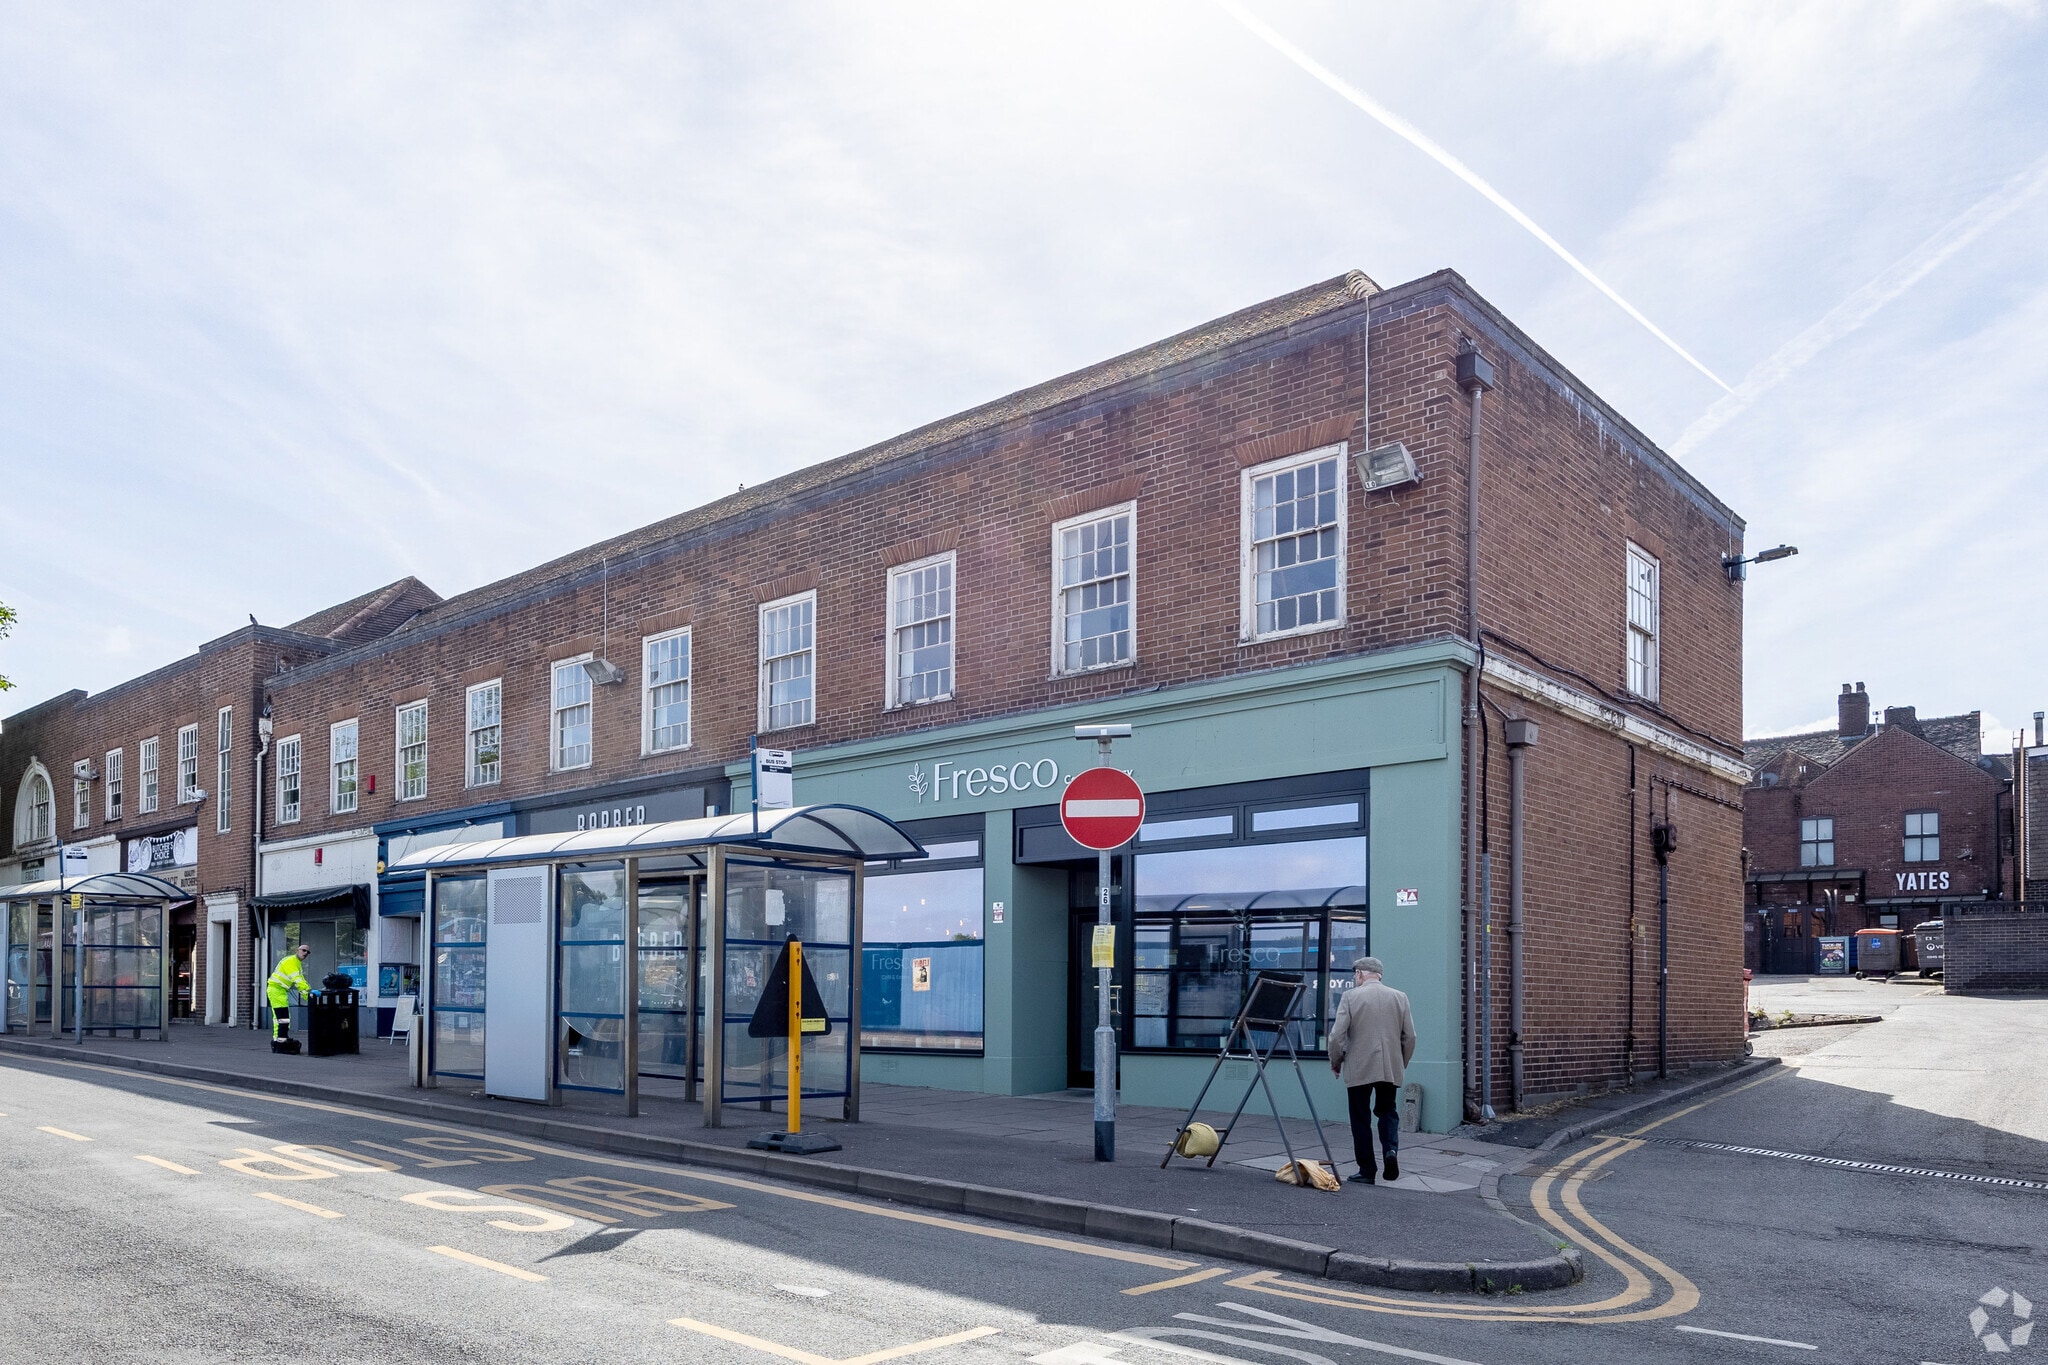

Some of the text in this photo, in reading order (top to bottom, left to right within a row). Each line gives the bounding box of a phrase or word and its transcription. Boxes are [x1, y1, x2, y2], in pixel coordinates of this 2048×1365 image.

[933, 758, 1059, 802] Fresco
[576, 804, 646, 831] BARBER
[1895, 871, 1950, 891] YATES
[219, 1136, 536, 1181] STOP
[399, 1176, 737, 1233] BUS
